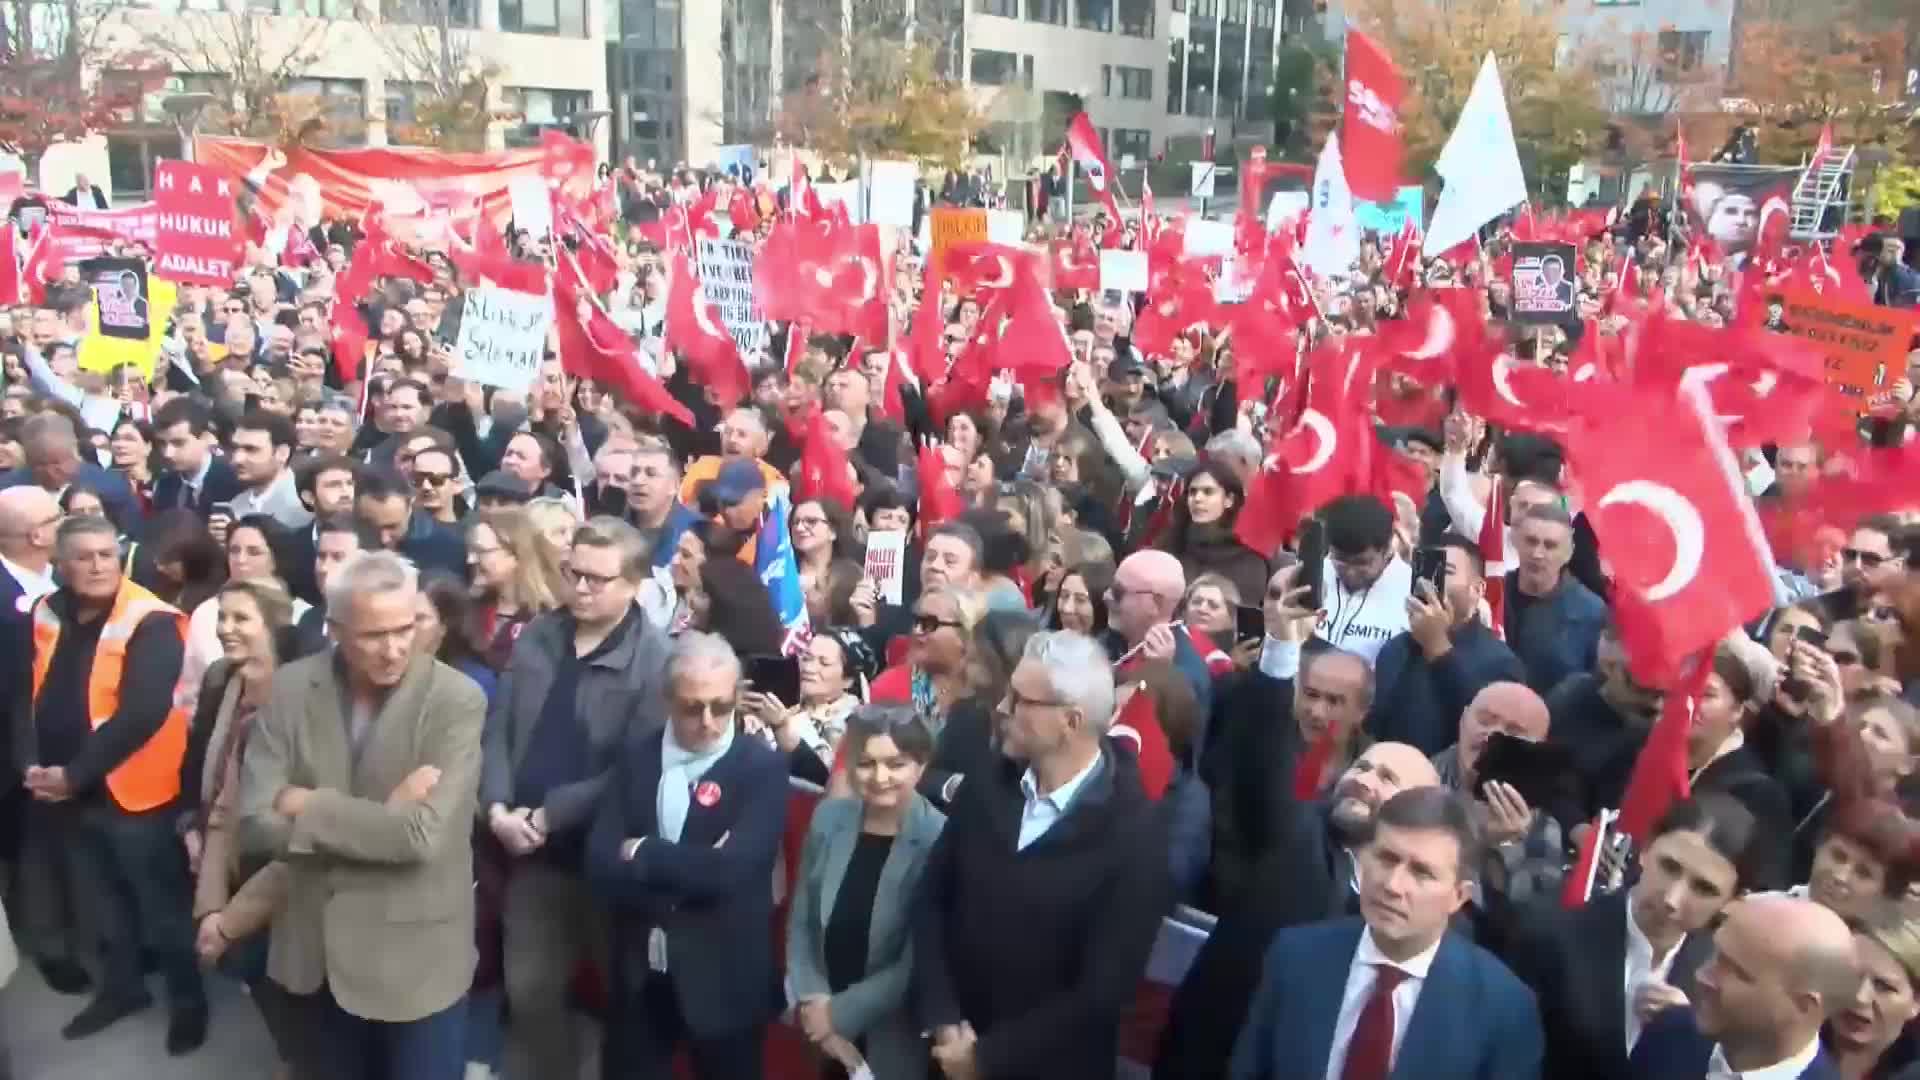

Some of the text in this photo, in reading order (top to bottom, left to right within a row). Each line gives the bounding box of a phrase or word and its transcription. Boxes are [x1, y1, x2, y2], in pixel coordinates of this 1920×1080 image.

[159, 171, 231, 198] HAK
[159, 212, 231, 239] HUKUK
[161, 253, 231, 278] ADALET
[1343, 623, 1392, 641] SMITH
